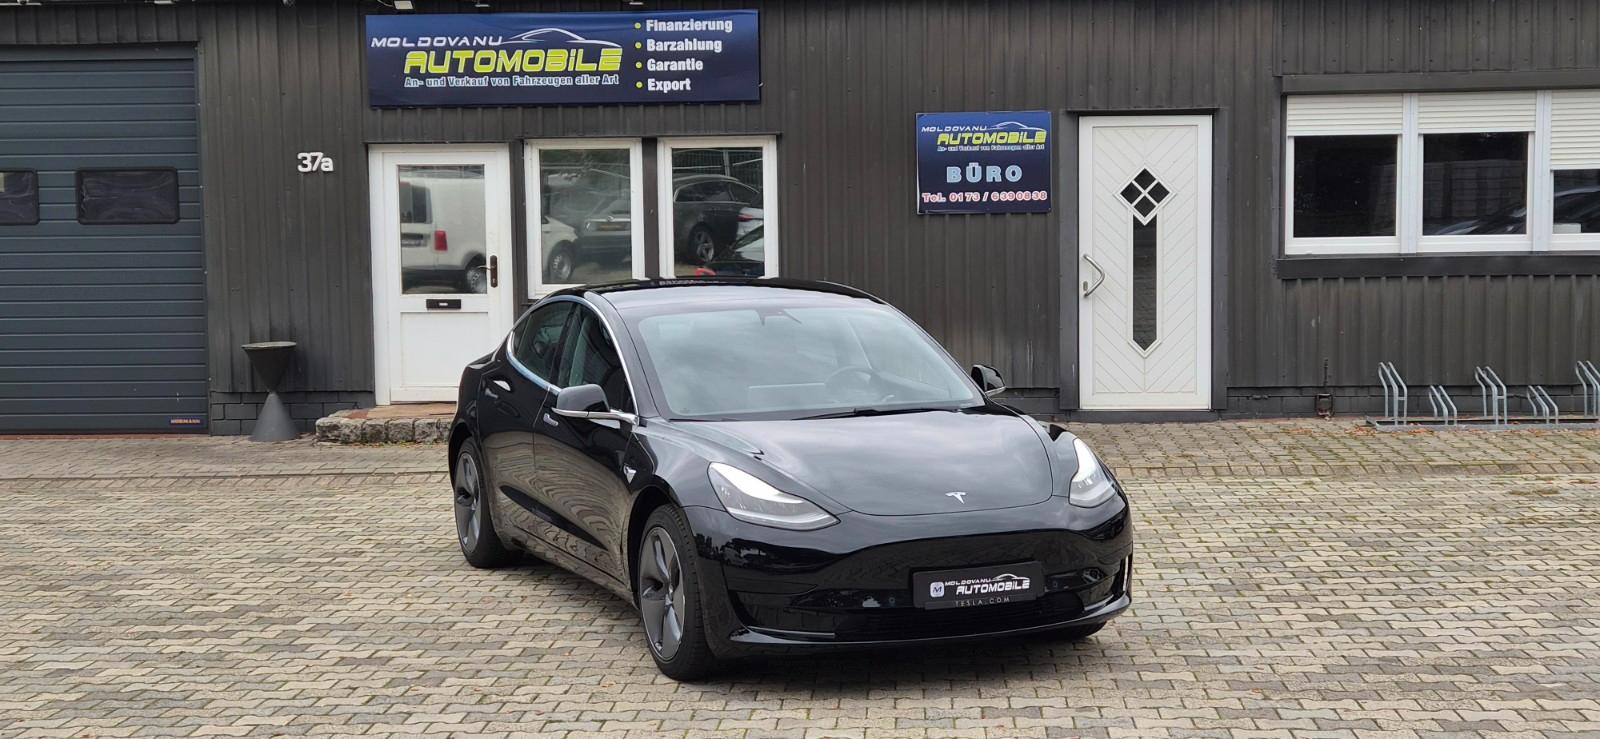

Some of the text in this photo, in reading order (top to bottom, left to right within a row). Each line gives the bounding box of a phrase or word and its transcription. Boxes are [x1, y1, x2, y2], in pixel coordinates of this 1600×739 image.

[646, 19, 733, 33] Finanzierung
[371, 36, 502, 48] MOLDOVANU
[646, 38, 722, 53] Barzahlung
[647, 58, 704, 71] Garantie
[404, 74, 619, 87] An- und Verkauf von Fahrzeugen aller Art
[647, 78, 691, 93] Export
[297, 151, 334, 172] 37a
[946, 162, 1023, 183] BÜRO
[922, 190, 1048, 203] Tel. 0173 / 6390838
[944, 578, 991, 586] MOLDOVANU
